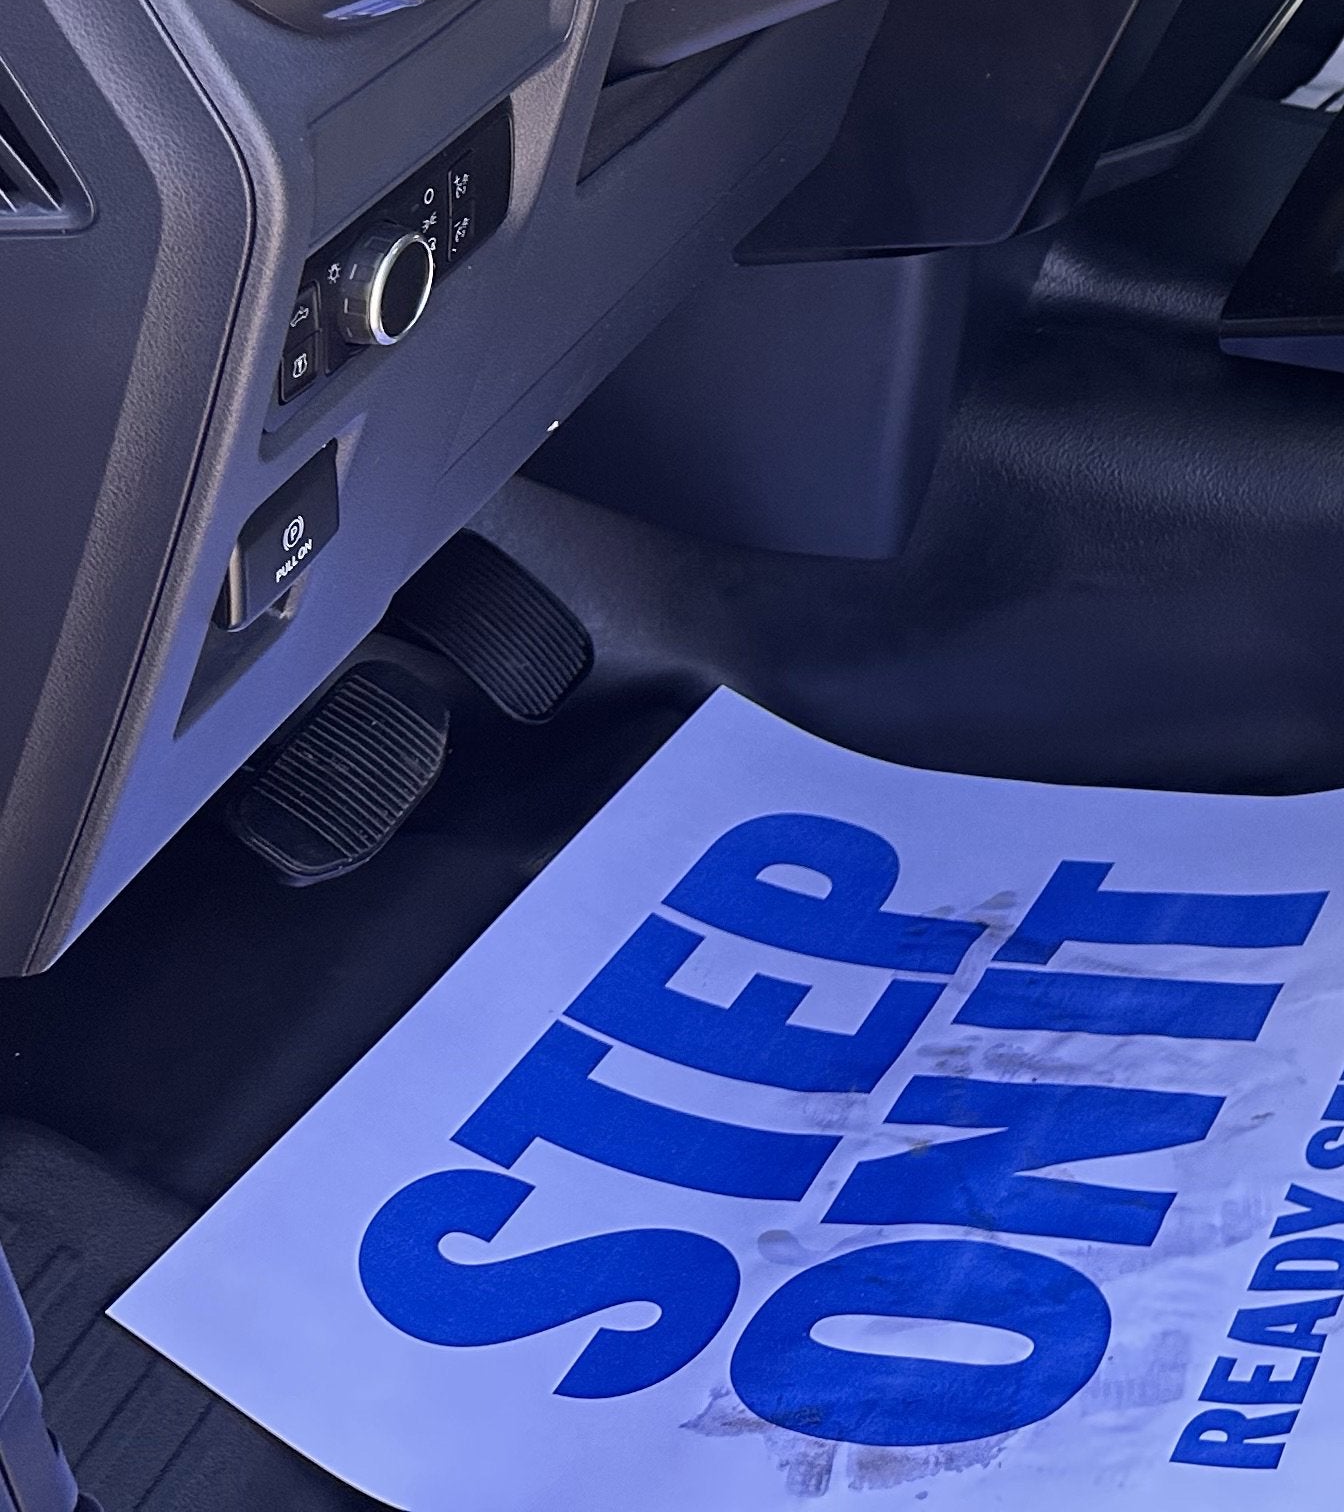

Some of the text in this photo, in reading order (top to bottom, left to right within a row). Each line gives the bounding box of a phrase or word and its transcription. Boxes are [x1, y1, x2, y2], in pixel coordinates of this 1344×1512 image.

[275, 538, 313, 584] PULL ON
[359, 813, 991, 1401] STEP
[730, 859, 1329, 1446] ON IT
